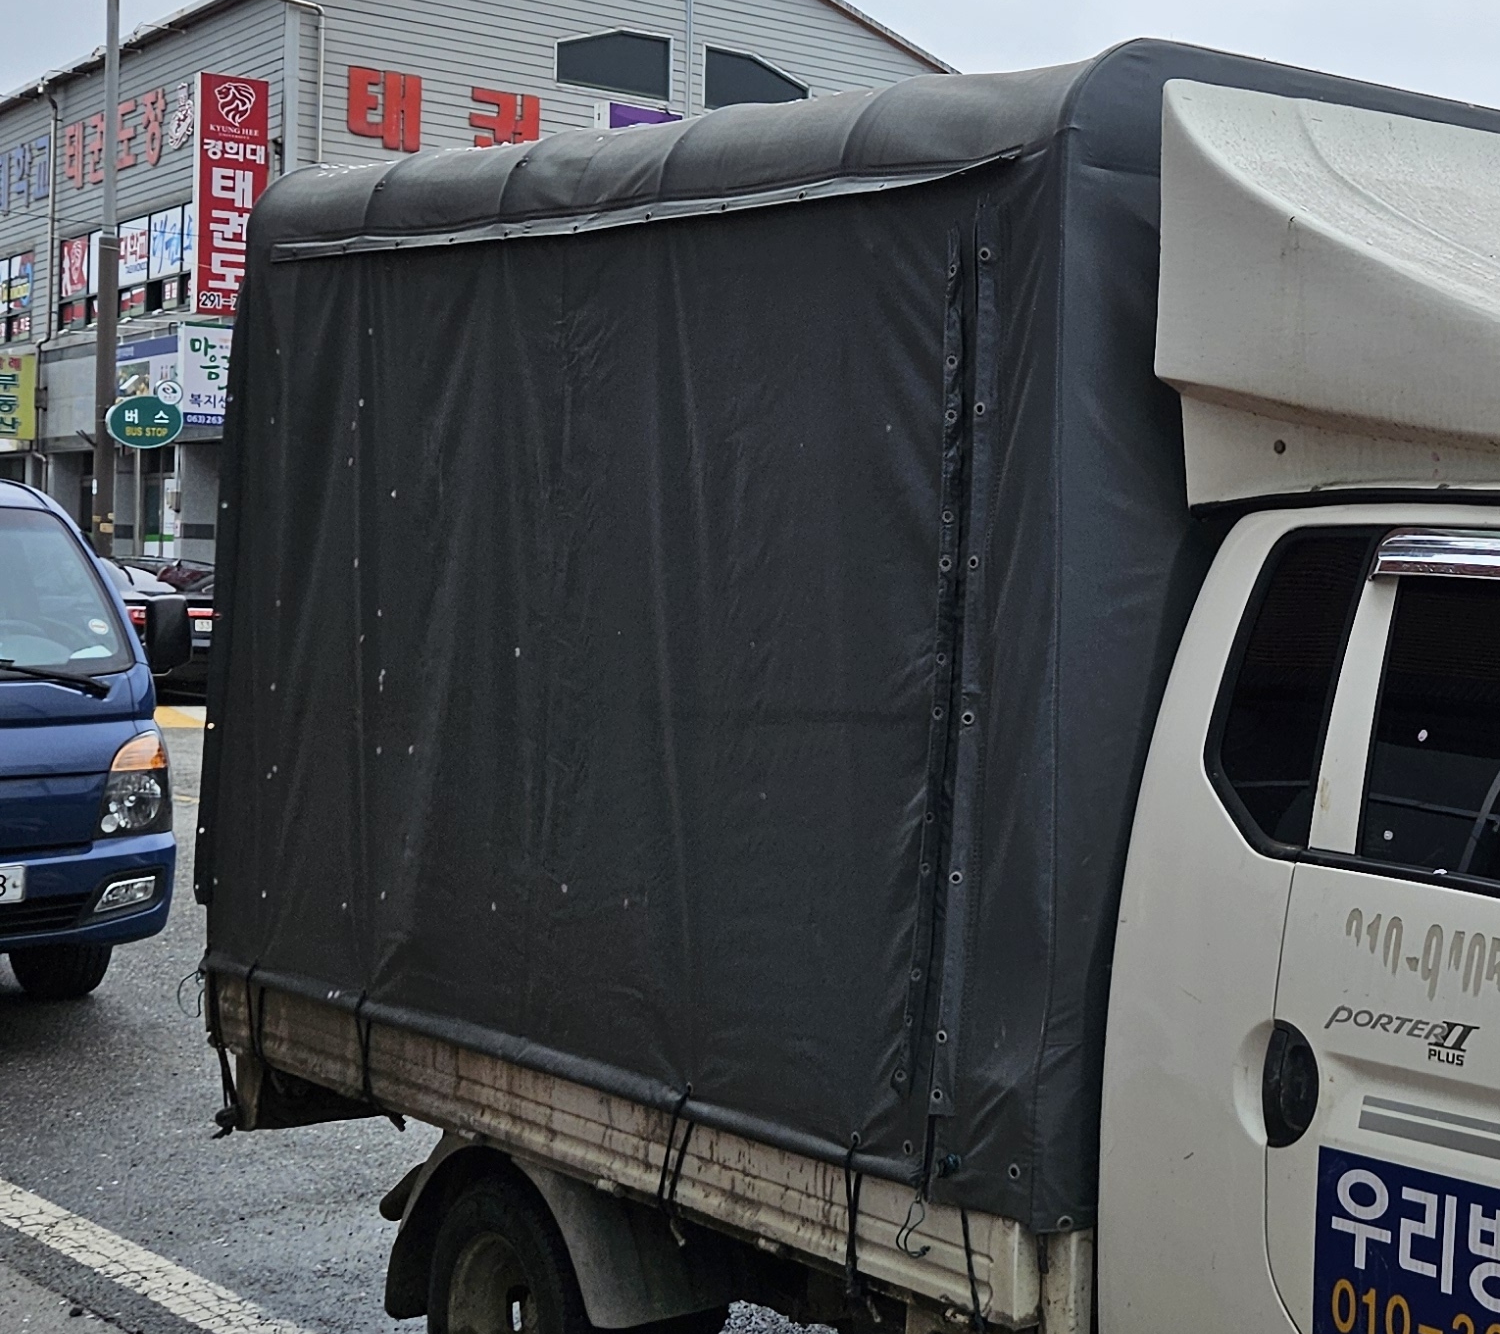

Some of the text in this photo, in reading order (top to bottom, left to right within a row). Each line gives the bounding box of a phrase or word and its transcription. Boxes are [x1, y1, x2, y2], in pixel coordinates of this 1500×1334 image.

[210, 124, 240, 134] KYUNG
[242, 128, 259, 137] HEE
[203, 138, 265, 164] 경희대
[209, 167, 253, 290] 태권도
[125, 427, 169, 437] BUS STOP
[1427, 1048, 1465, 1067] PLUS
